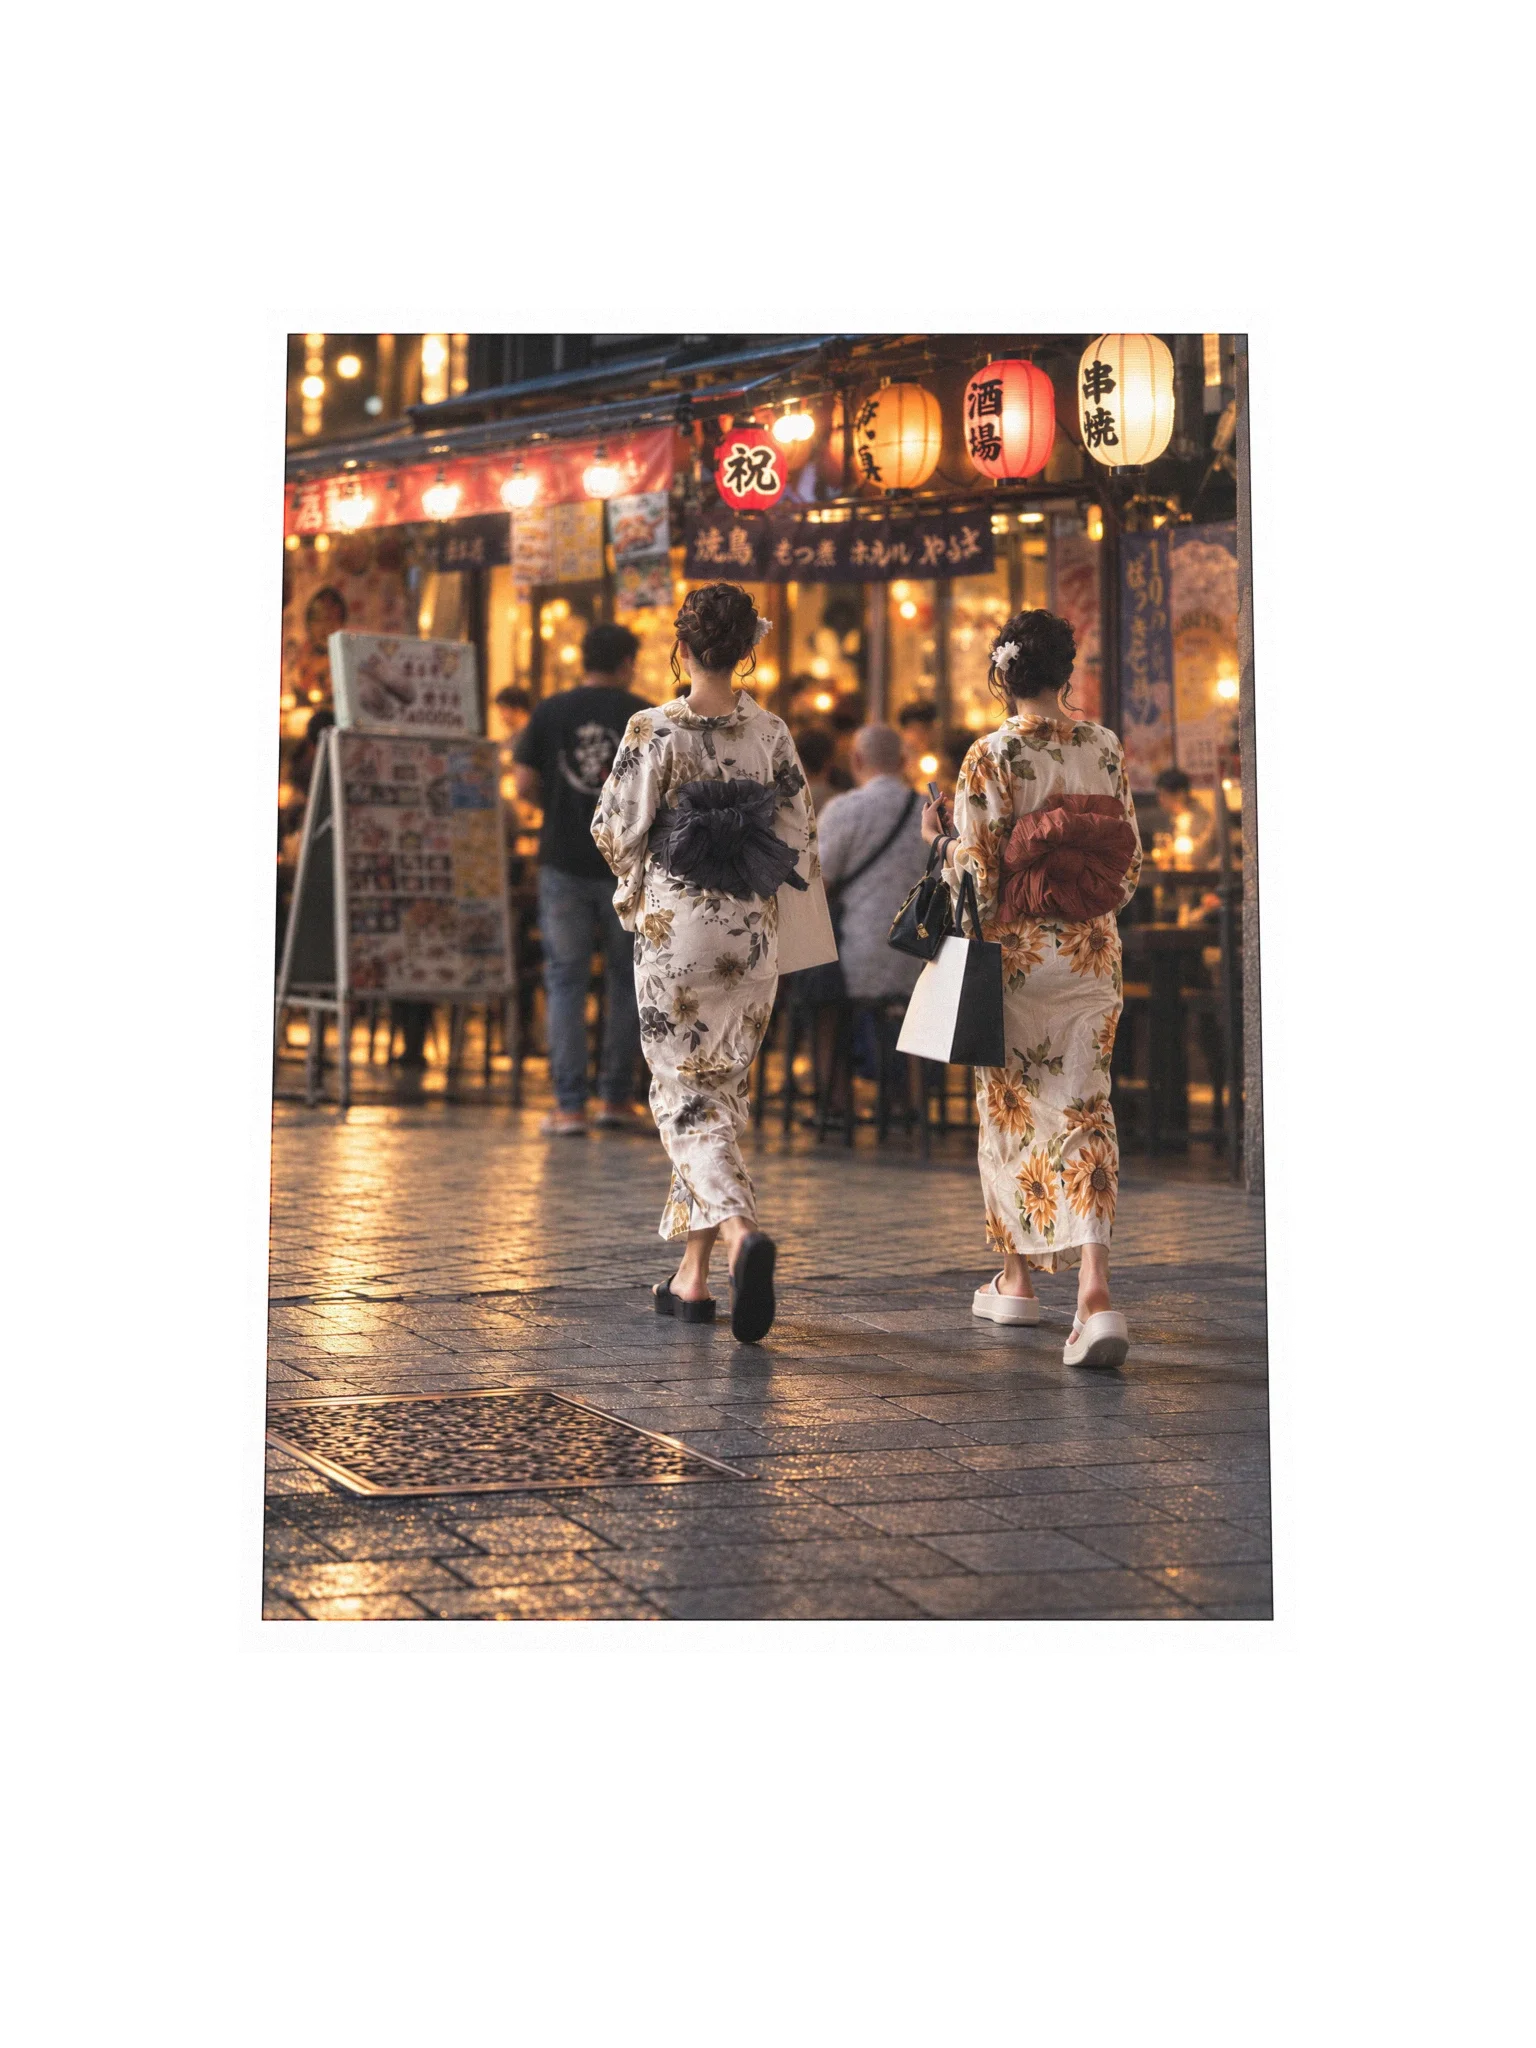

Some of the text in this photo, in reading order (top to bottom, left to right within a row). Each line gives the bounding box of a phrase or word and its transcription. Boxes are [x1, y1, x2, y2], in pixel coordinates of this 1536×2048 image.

[968, 378, 1004, 461] 酒場
[1082, 360, 1119, 449] 串焼
[723, 443, 781, 497] 祝
